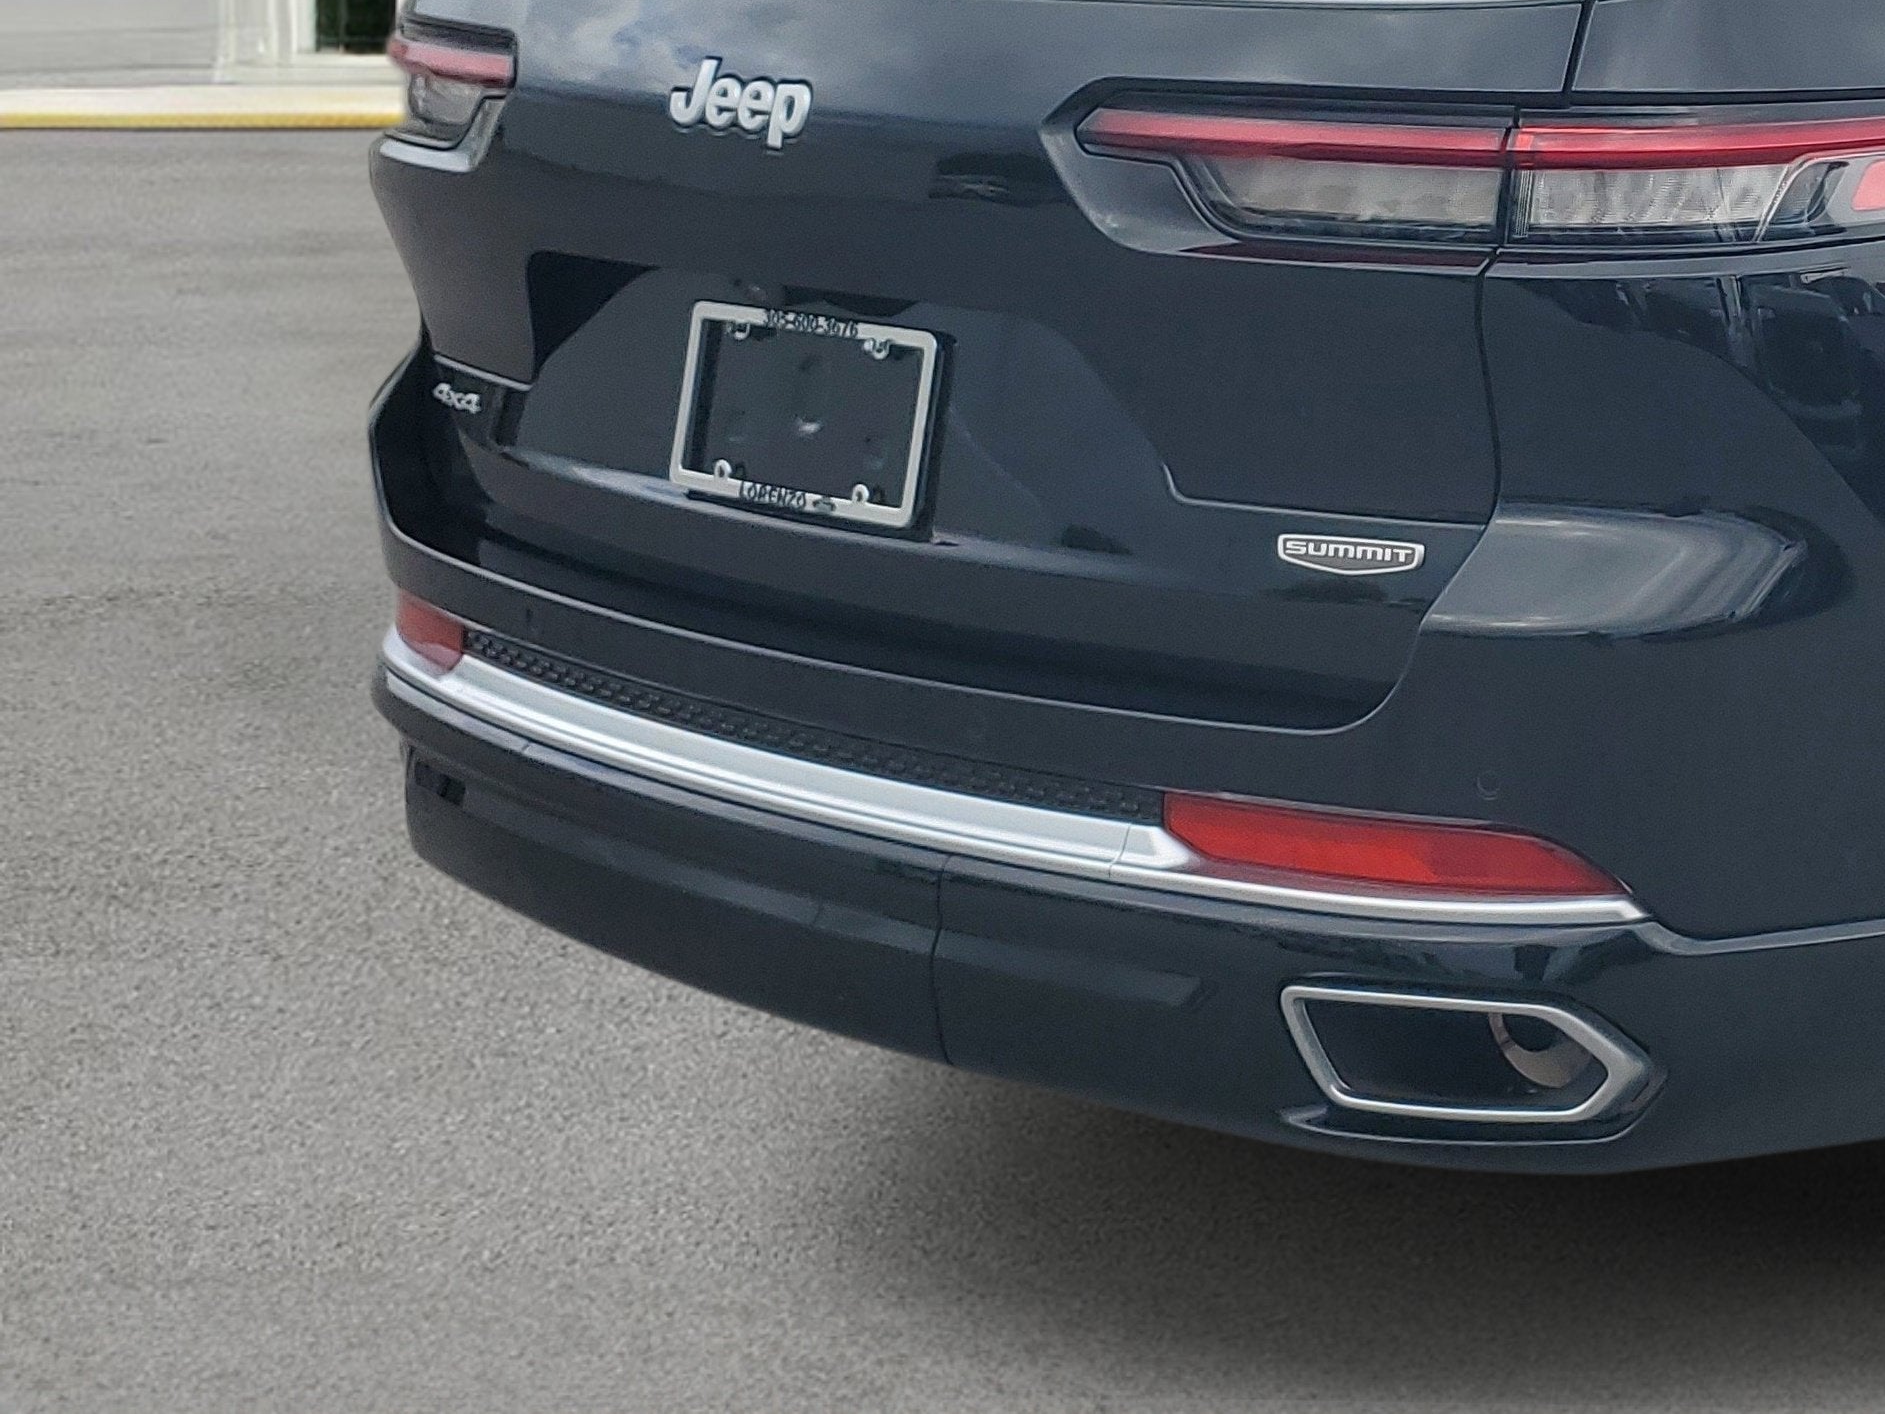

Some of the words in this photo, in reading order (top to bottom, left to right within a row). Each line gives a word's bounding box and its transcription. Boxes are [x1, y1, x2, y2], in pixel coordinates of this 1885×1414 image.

[669, 57, 812, 150] Jeep
[433, 382, 481, 414] 4x4
[738, 479, 808, 508] LORENZO
[1285, 540, 1413, 563] SUMMIT
